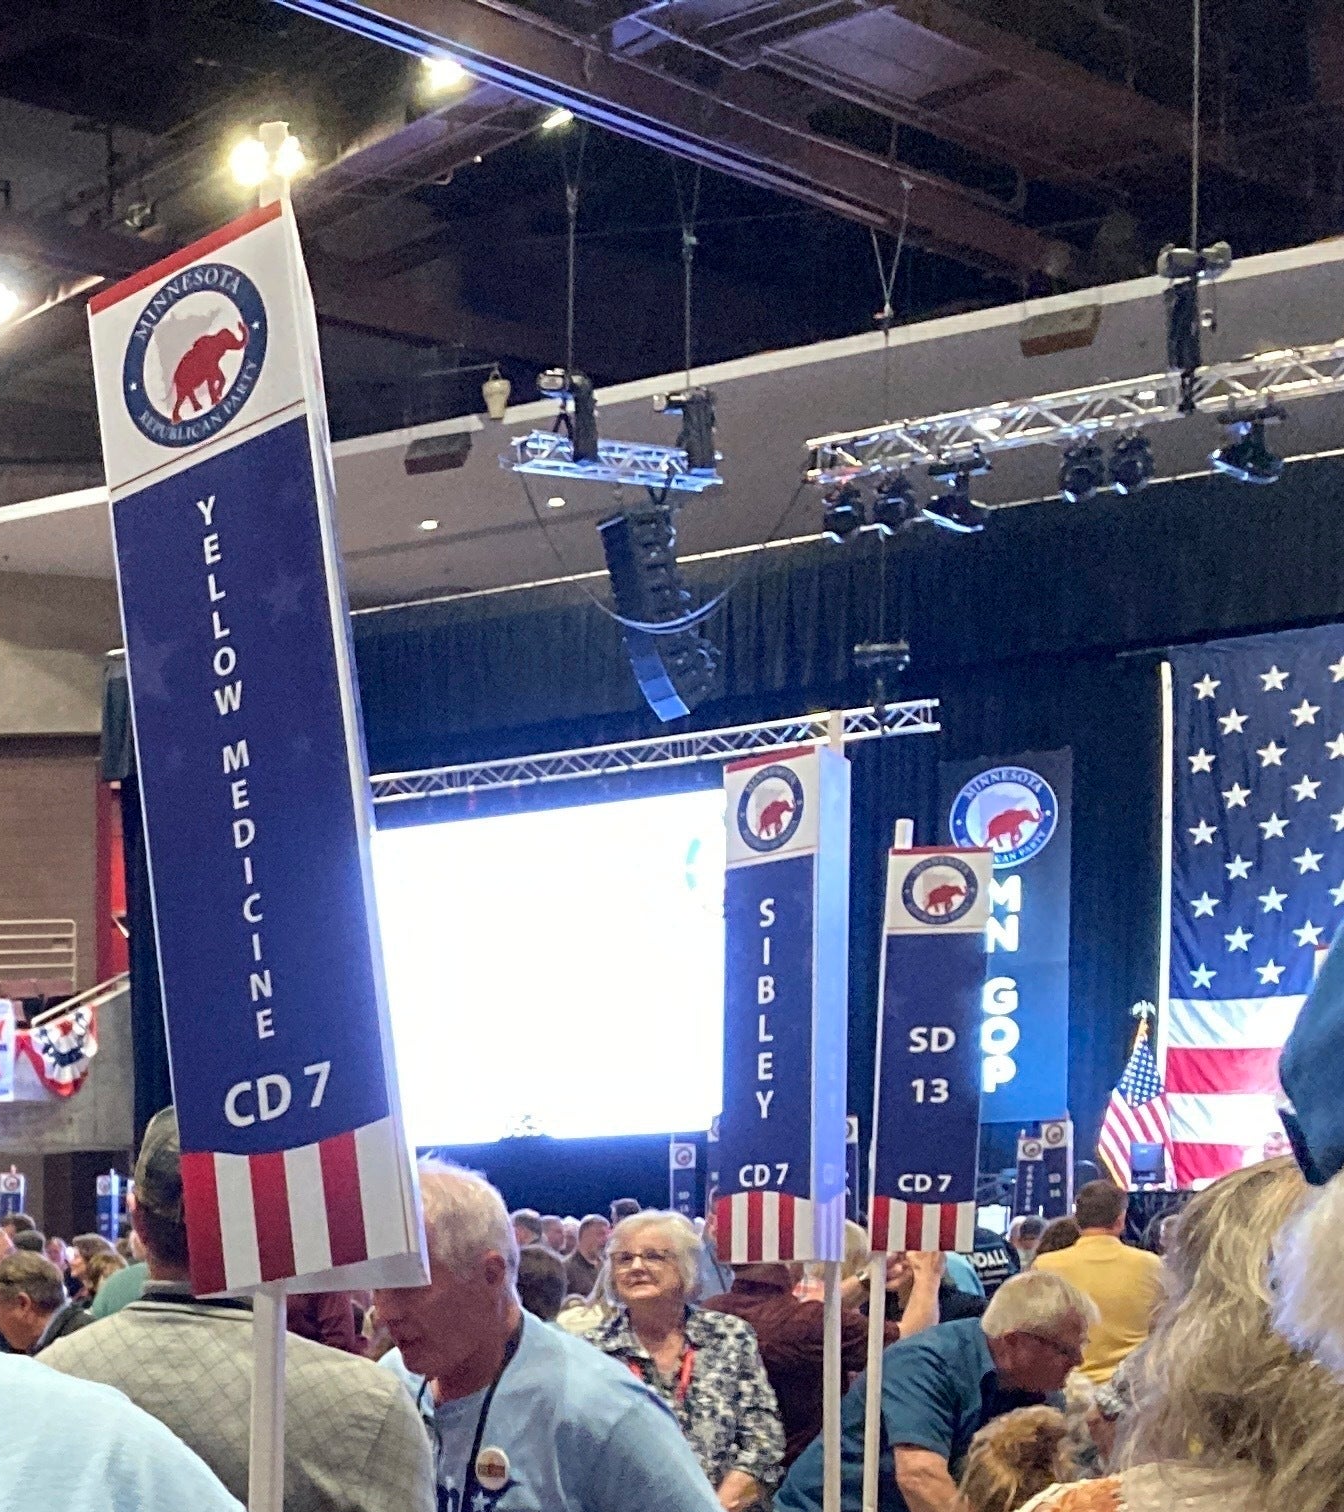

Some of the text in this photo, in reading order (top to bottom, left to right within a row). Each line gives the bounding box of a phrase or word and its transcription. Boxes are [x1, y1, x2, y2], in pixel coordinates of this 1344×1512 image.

[135, 268, 241, 341] MINNESOTA
[139, 359, 258, 440] REPUBLICAN PARTY
[196, 495, 276, 1040] YELLOW MEDICINE
[962, 770, 1043, 800] MINNESOTA
[985, 874, 1022, 953] MN
[756, 897, 776, 1119] SIBLEY
[908, 1026, 957, 1053] SD
[980, 976, 1021, 1094] GOP
[224, 1060, 332, 1128] CD 7
[911, 1078, 950, 1104] 13
[738, 1162, 790, 1188] CD 7
[897, 1173, 953, 1193] CD 7
